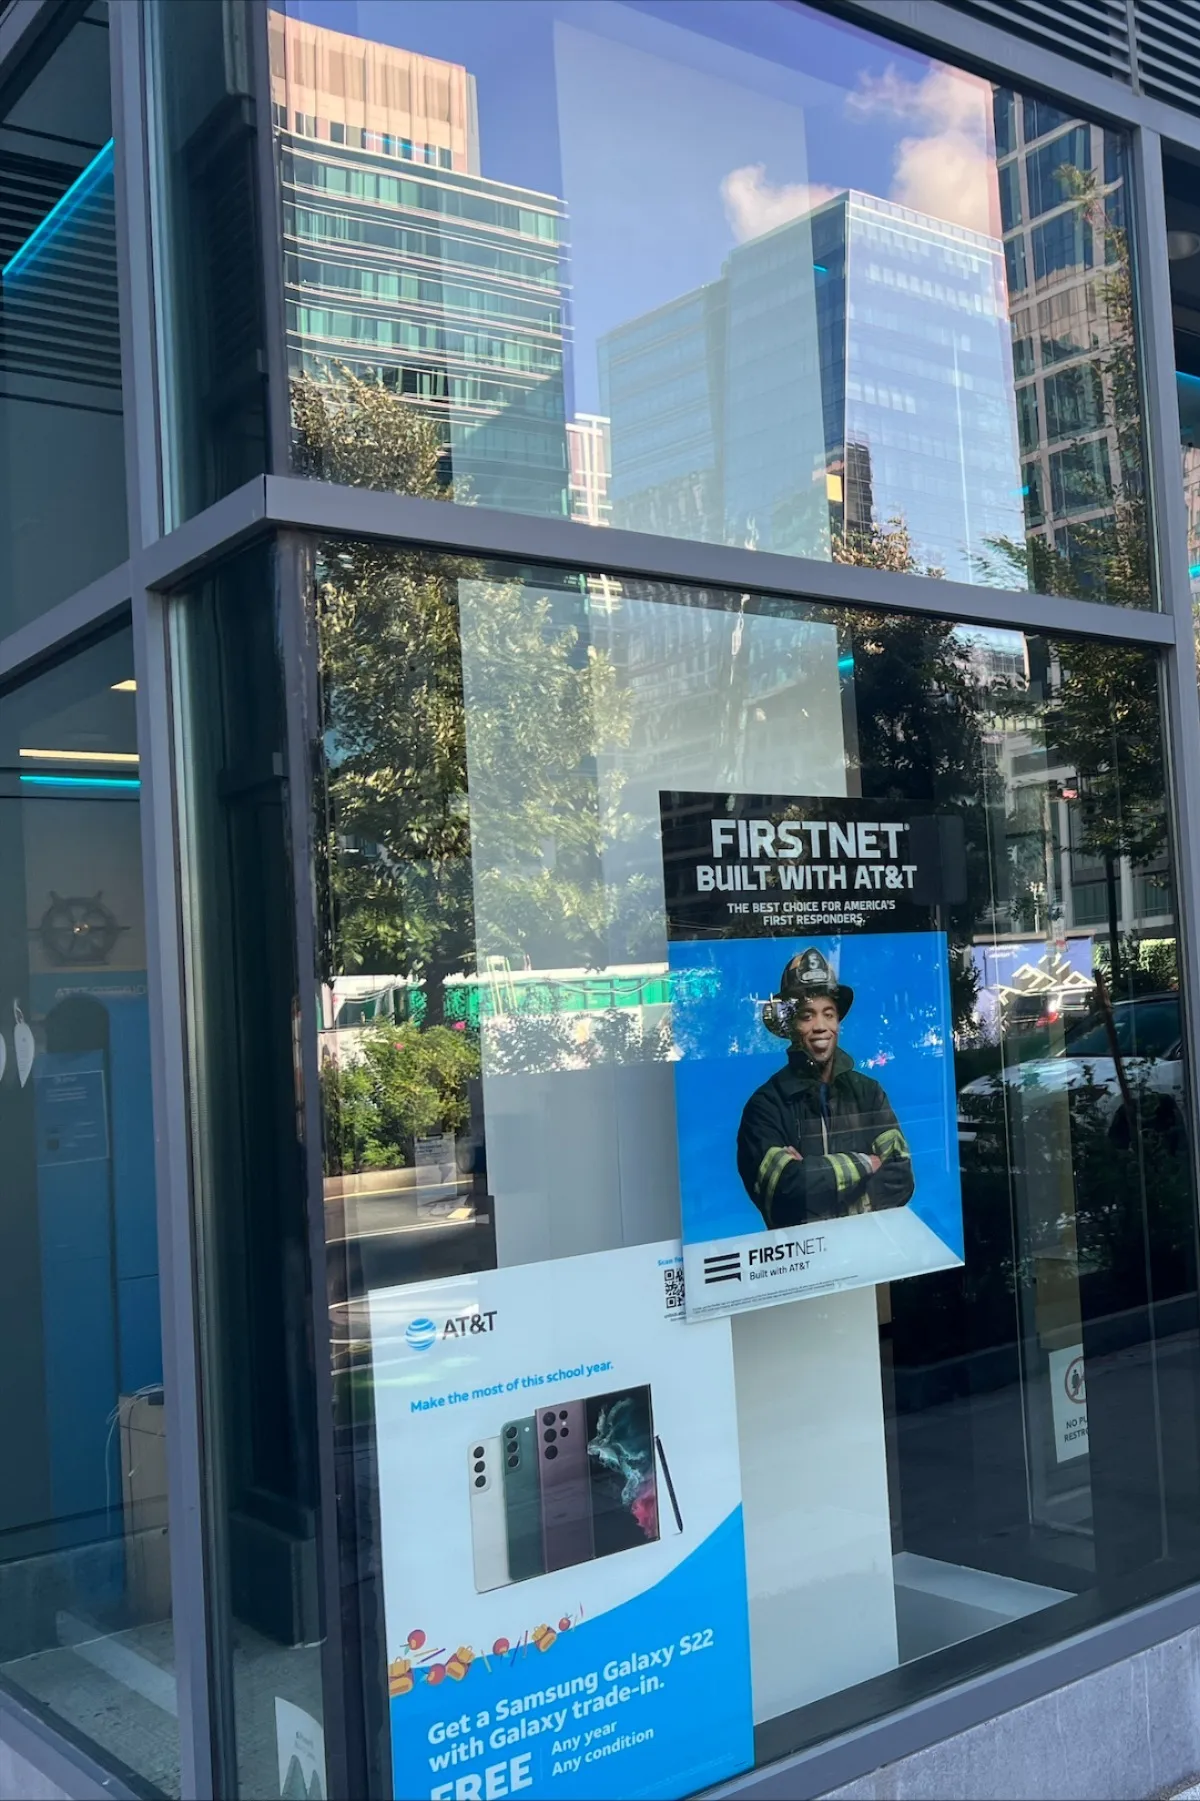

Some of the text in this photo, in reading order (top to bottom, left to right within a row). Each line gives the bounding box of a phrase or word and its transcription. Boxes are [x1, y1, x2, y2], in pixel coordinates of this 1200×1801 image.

[696, 865, 918, 891] BUILT WITH AT&T
[727, 900, 896, 914] THE BEST CHOICE FOR AMERICA'S
[763, 915, 793, 926] FIRST
[749, 1260, 811, 1281] Built with AT&T
[441, 1310, 499, 1340] AT&T
[411, 1359, 614, 1413] Make the most of this school year.
[1066, 1420, 1078, 1429] NO
[427, 1628, 715, 1744] Get a Samsung Galaxy S22
[428, 1673, 666, 1773] with Galaxy trade-in.
[551, 1719, 618, 1756] Any year
[551, 1727, 655, 1777] Any condition
[429, 1752, 533, 1801] FREE
